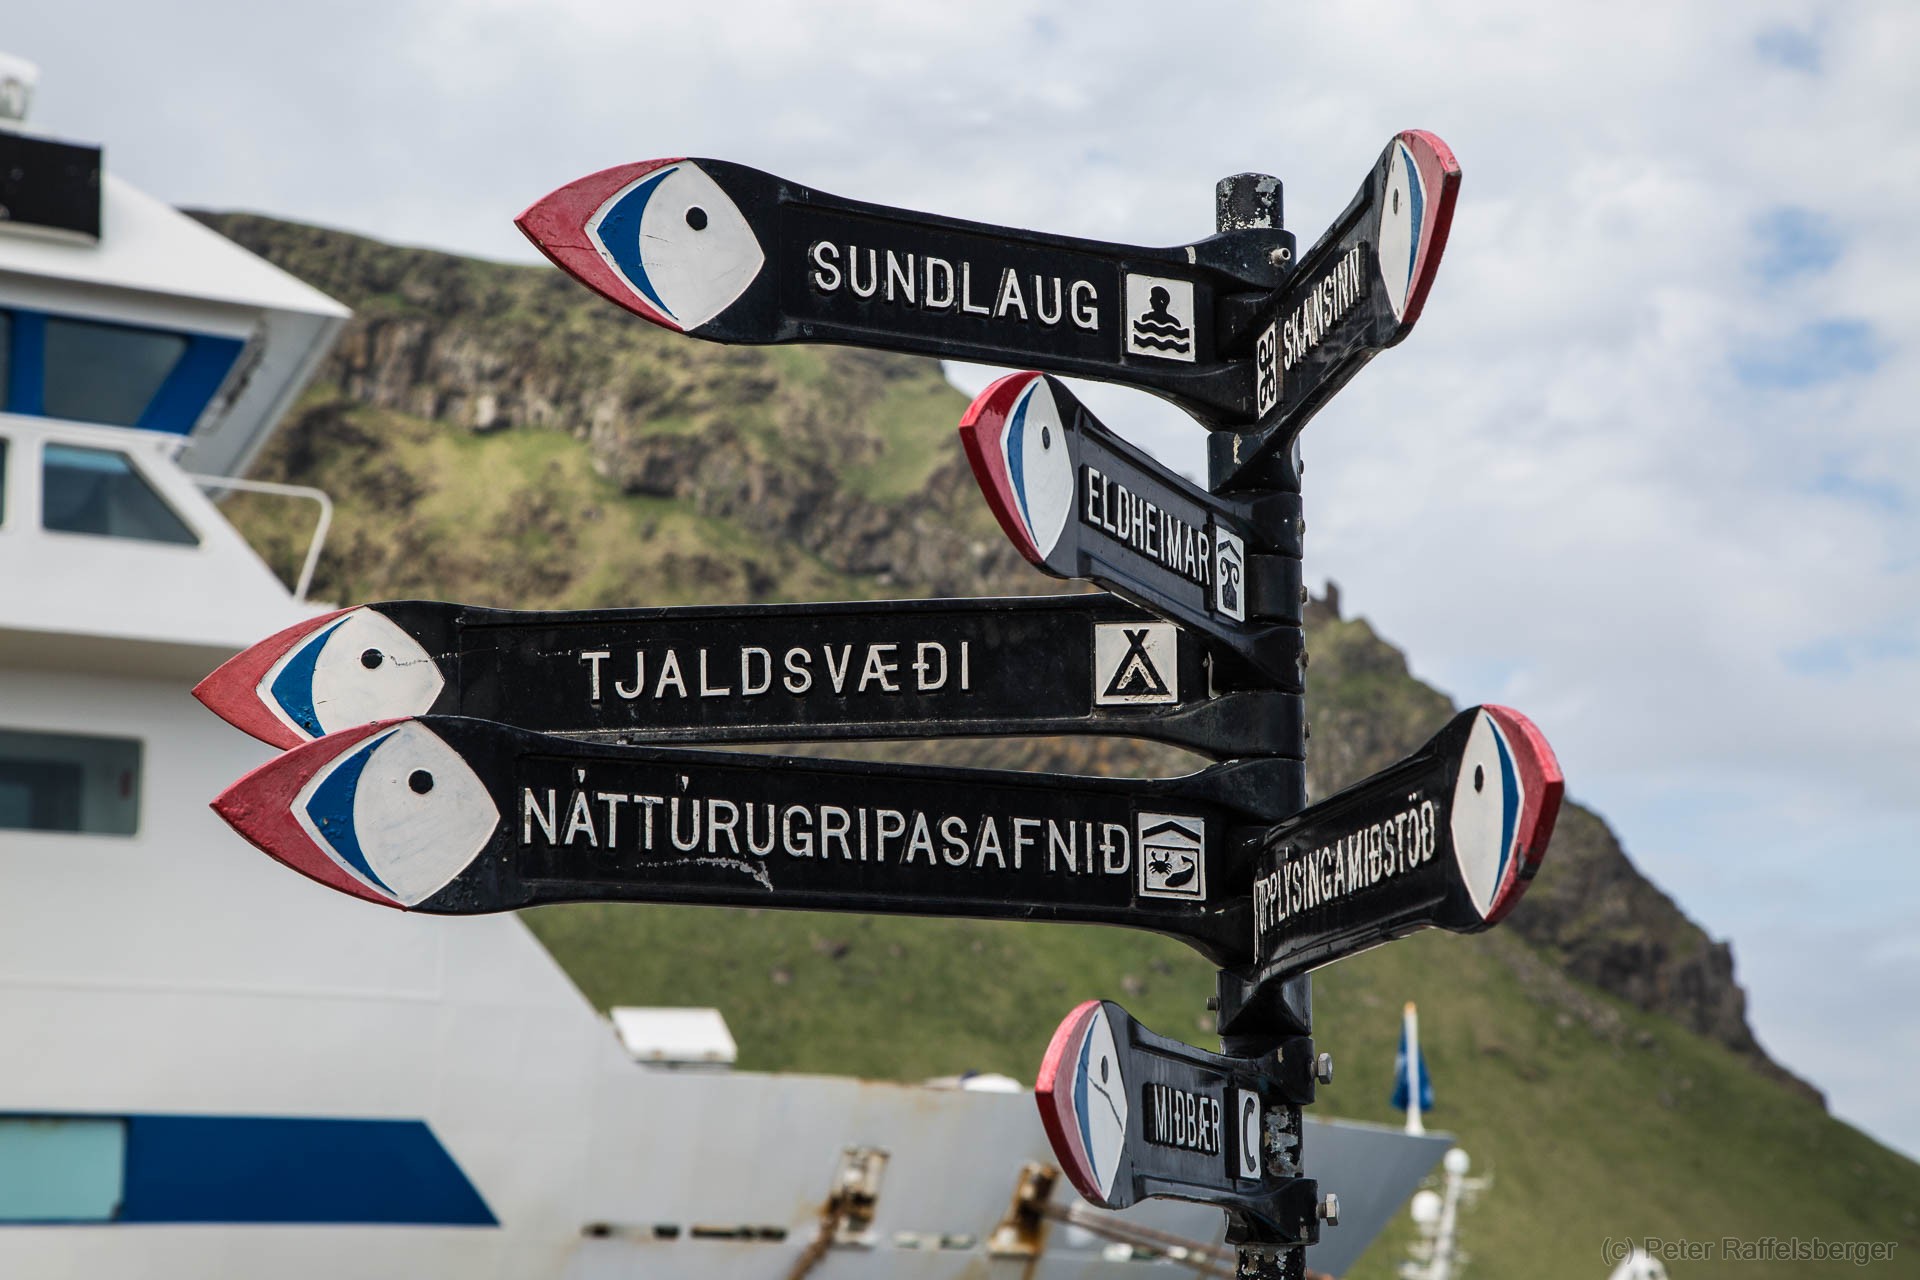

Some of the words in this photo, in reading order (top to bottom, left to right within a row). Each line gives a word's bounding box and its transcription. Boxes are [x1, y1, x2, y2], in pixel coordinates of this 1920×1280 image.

[813, 240, 1099, 331] SUNDLAUG
[1283, 247, 1360, 370] SKANSINN
[1087, 466, 1211, 586] ELDHEIMAR
[581, 641, 970, 700] TJALDSVÆÐI
[523, 769, 1131, 874] NÁTTÚRUGRIPASAFNIÐ
[1153, 1083, 1221, 1154] MIÐBÆR
